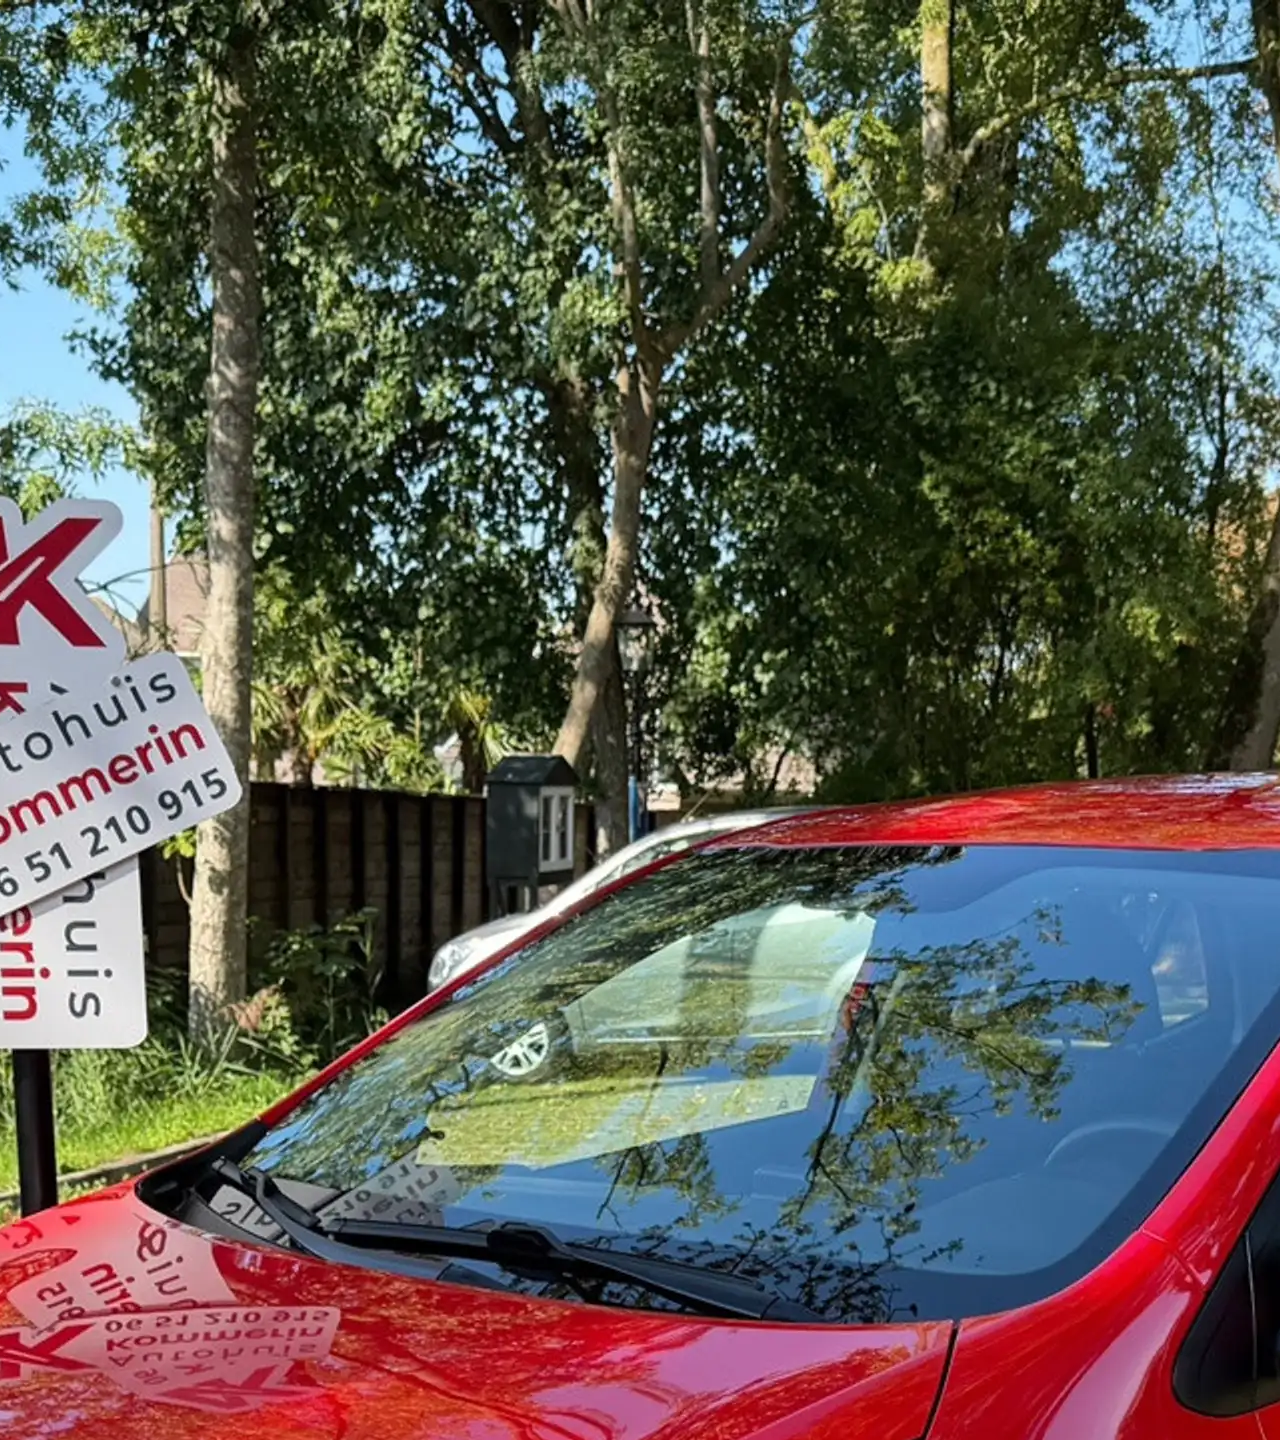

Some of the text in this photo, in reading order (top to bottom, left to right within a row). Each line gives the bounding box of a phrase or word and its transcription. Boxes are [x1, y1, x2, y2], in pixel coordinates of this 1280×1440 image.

[24, 841, 73, 884] 51
[79, 804, 152, 858] 210
[157, 767, 228, 821] 915
